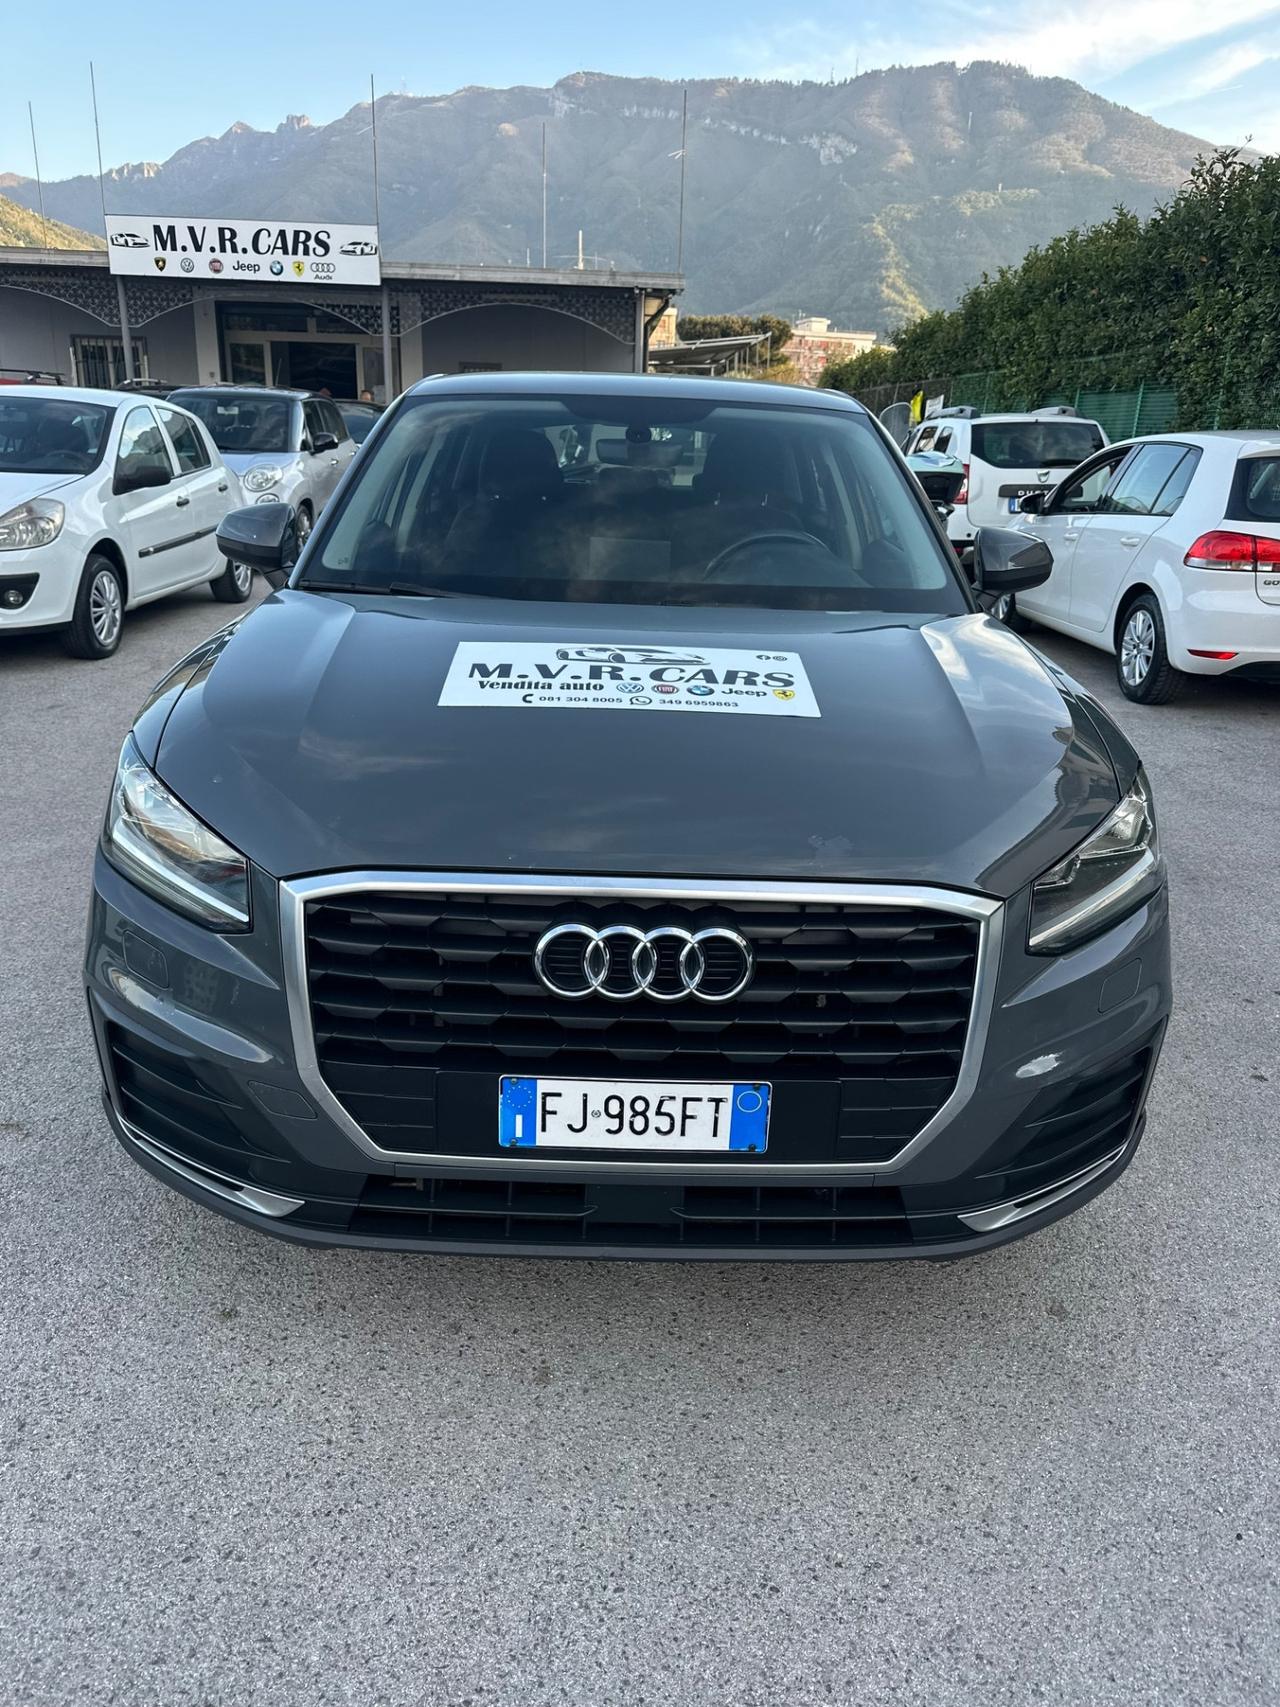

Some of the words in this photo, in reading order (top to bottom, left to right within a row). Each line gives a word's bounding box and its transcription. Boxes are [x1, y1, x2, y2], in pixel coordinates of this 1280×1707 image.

[232, 260, 260, 274] Jeep
[478, 680, 553, 690] Vendita
[559, 681, 605, 691] auto
[721, 687, 768, 698] Jeep
